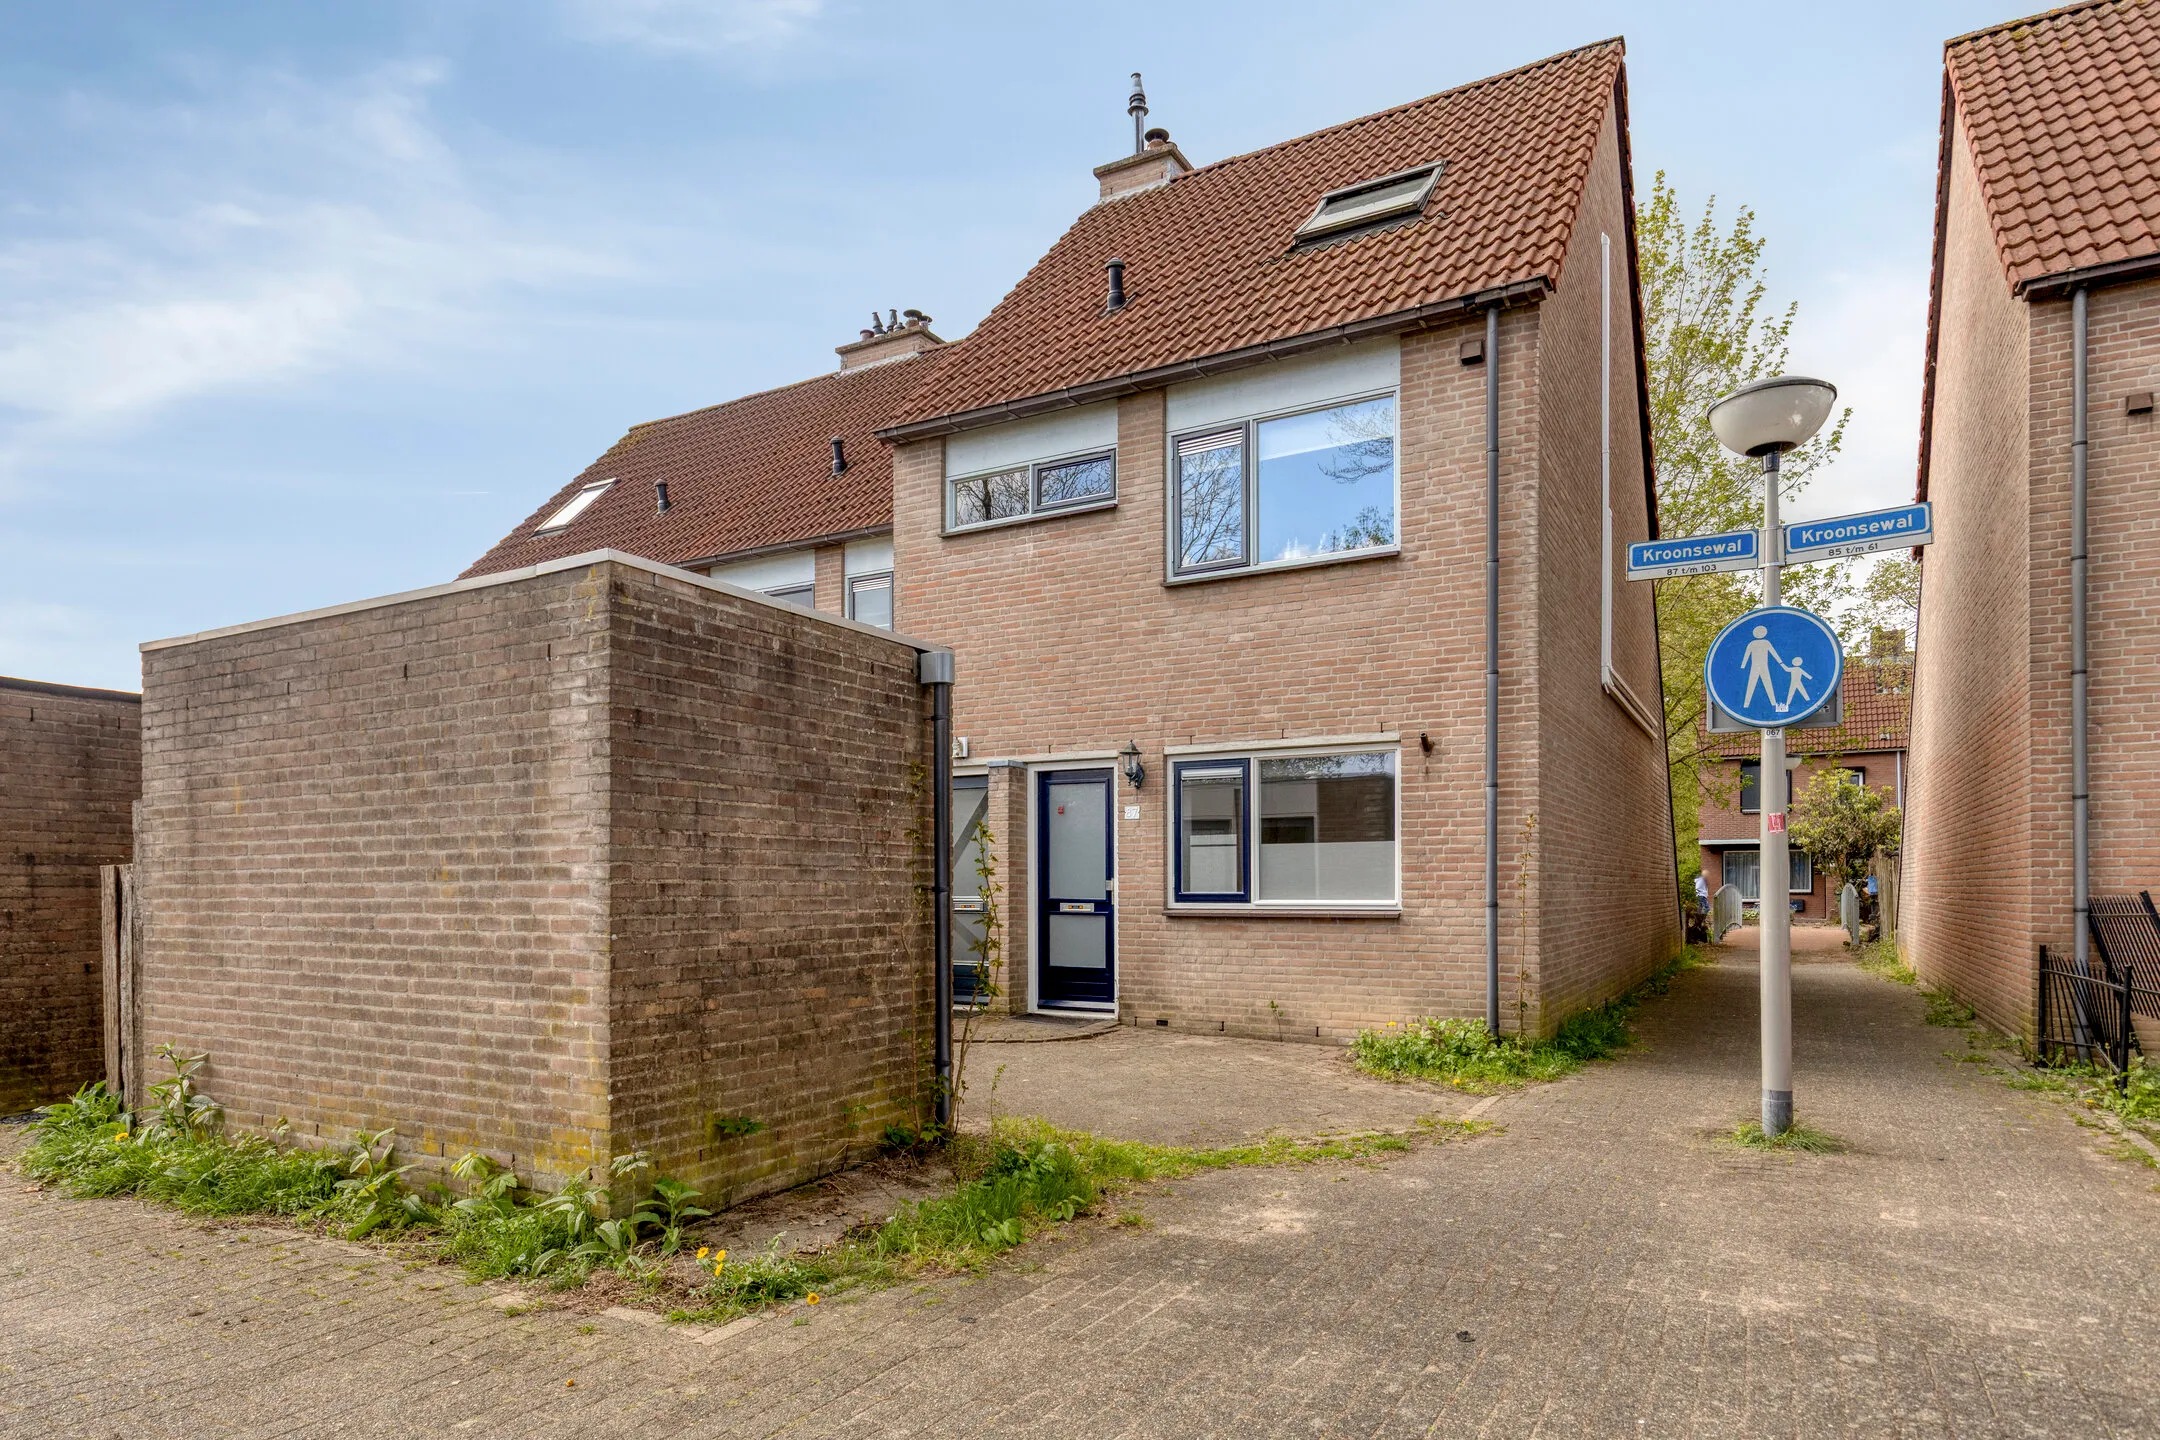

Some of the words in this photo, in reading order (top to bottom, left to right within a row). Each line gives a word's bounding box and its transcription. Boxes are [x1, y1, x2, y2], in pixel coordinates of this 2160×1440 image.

[1802, 514, 1913, 543] Kroonsewal
[1643, 539, 1741, 562] Kroonsewal
[1828, 548, 1842, 557] 85
[1845, 545, 1864, 555] t/m
[1868, 543, 1878, 551] 61
[1667, 568, 1679, 576] 87
[1682, 565, 1698, 574] t/m
[1701, 563, 1717, 572] 103
